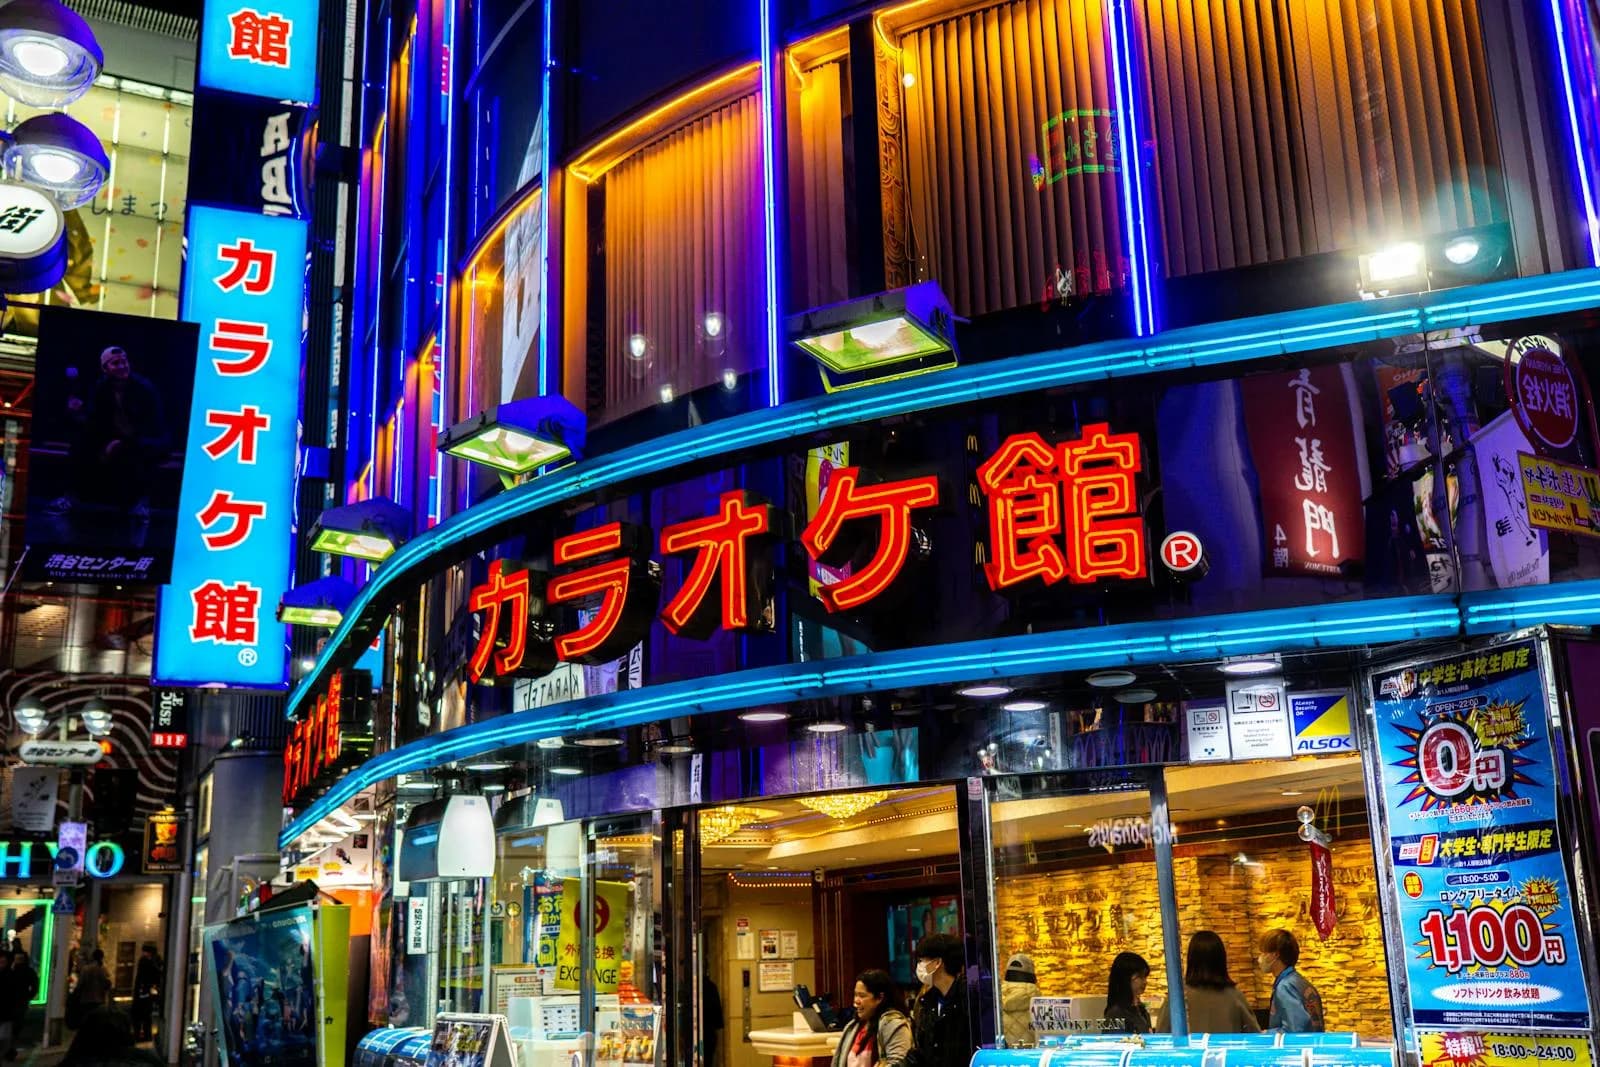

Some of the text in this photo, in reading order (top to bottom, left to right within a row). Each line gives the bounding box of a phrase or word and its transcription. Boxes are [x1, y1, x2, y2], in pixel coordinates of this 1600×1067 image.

[226, 7, 293, 69] 館
[188, 237, 277, 646] カラオケ館
[467, 422, 1147, 684] カラオケ館
[1297, 737, 1352, 751] ALSOK
[1421, 904, 1566, 973] 1,100円
